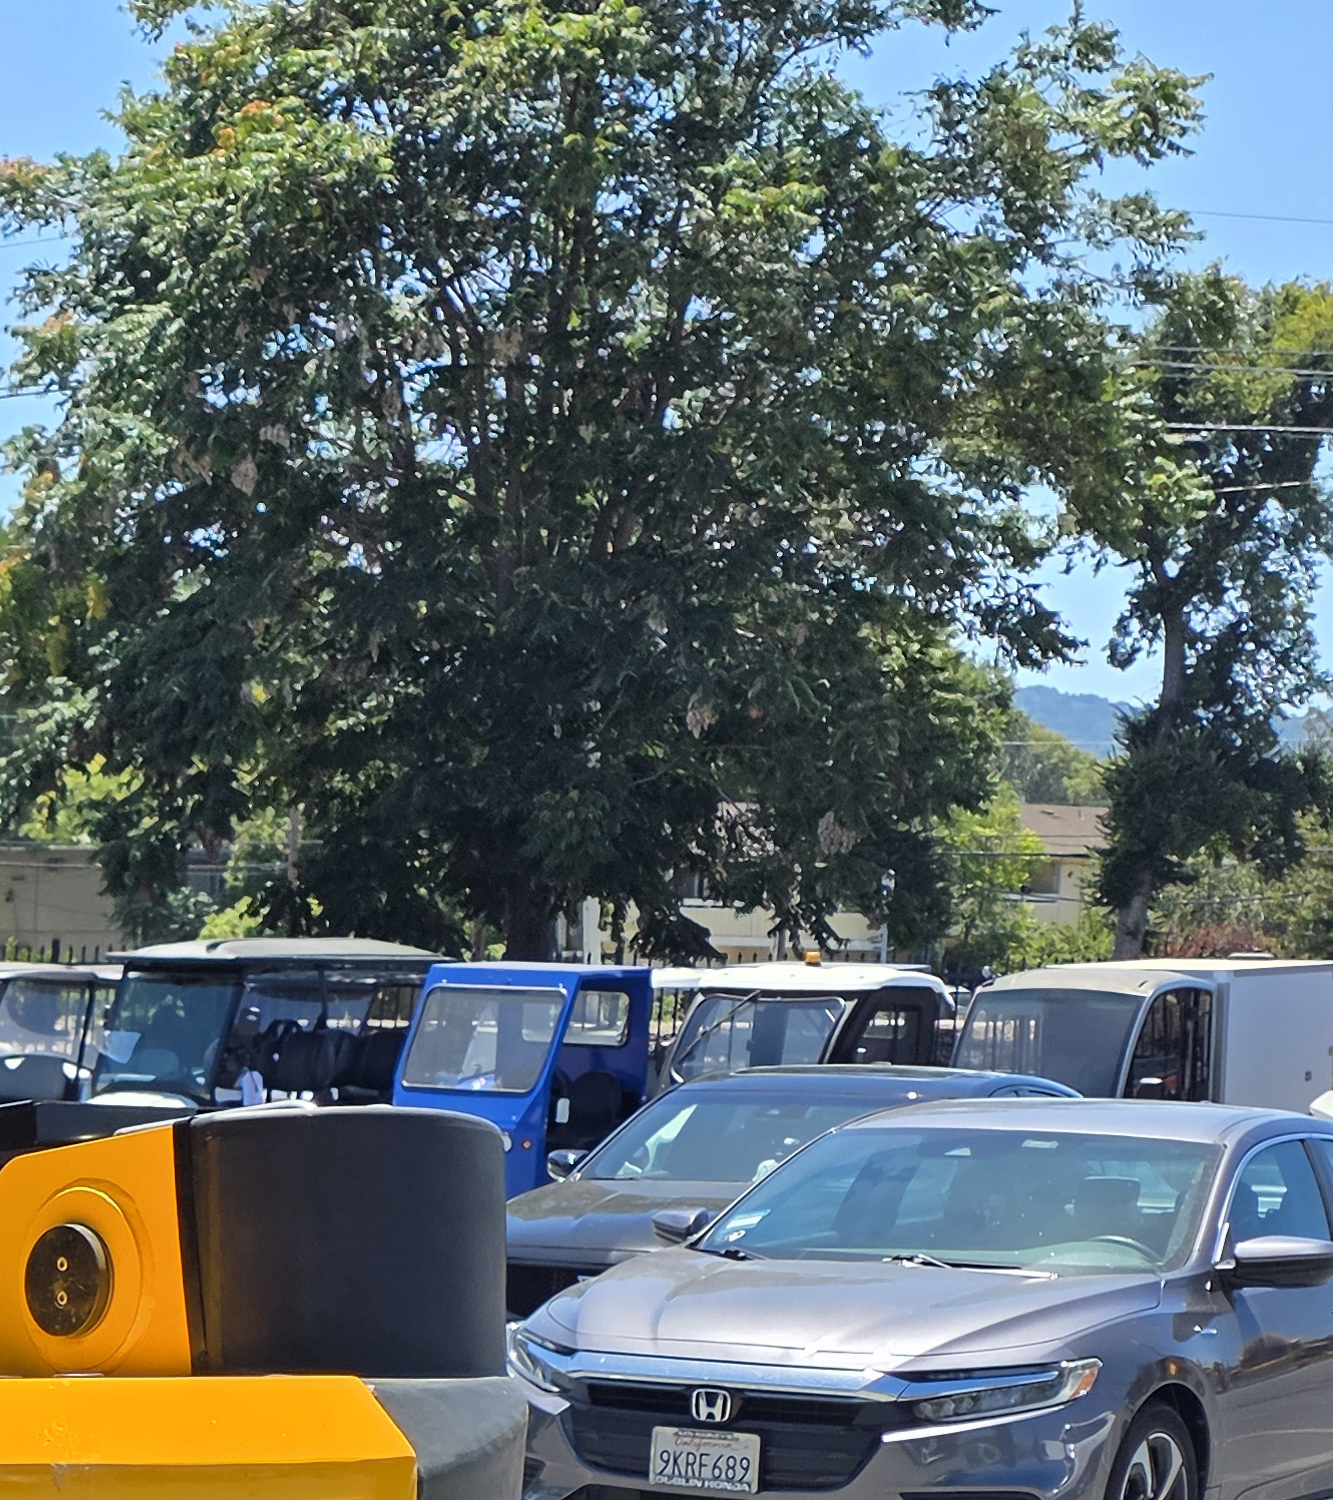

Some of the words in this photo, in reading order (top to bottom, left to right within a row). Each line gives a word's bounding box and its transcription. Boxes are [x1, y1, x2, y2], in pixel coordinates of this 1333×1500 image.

[656, 1450, 751, 1483] 9KRF689
[655, 1476, 703, 1487] DUBLIN
[704, 1480, 751, 1492] HONDA
